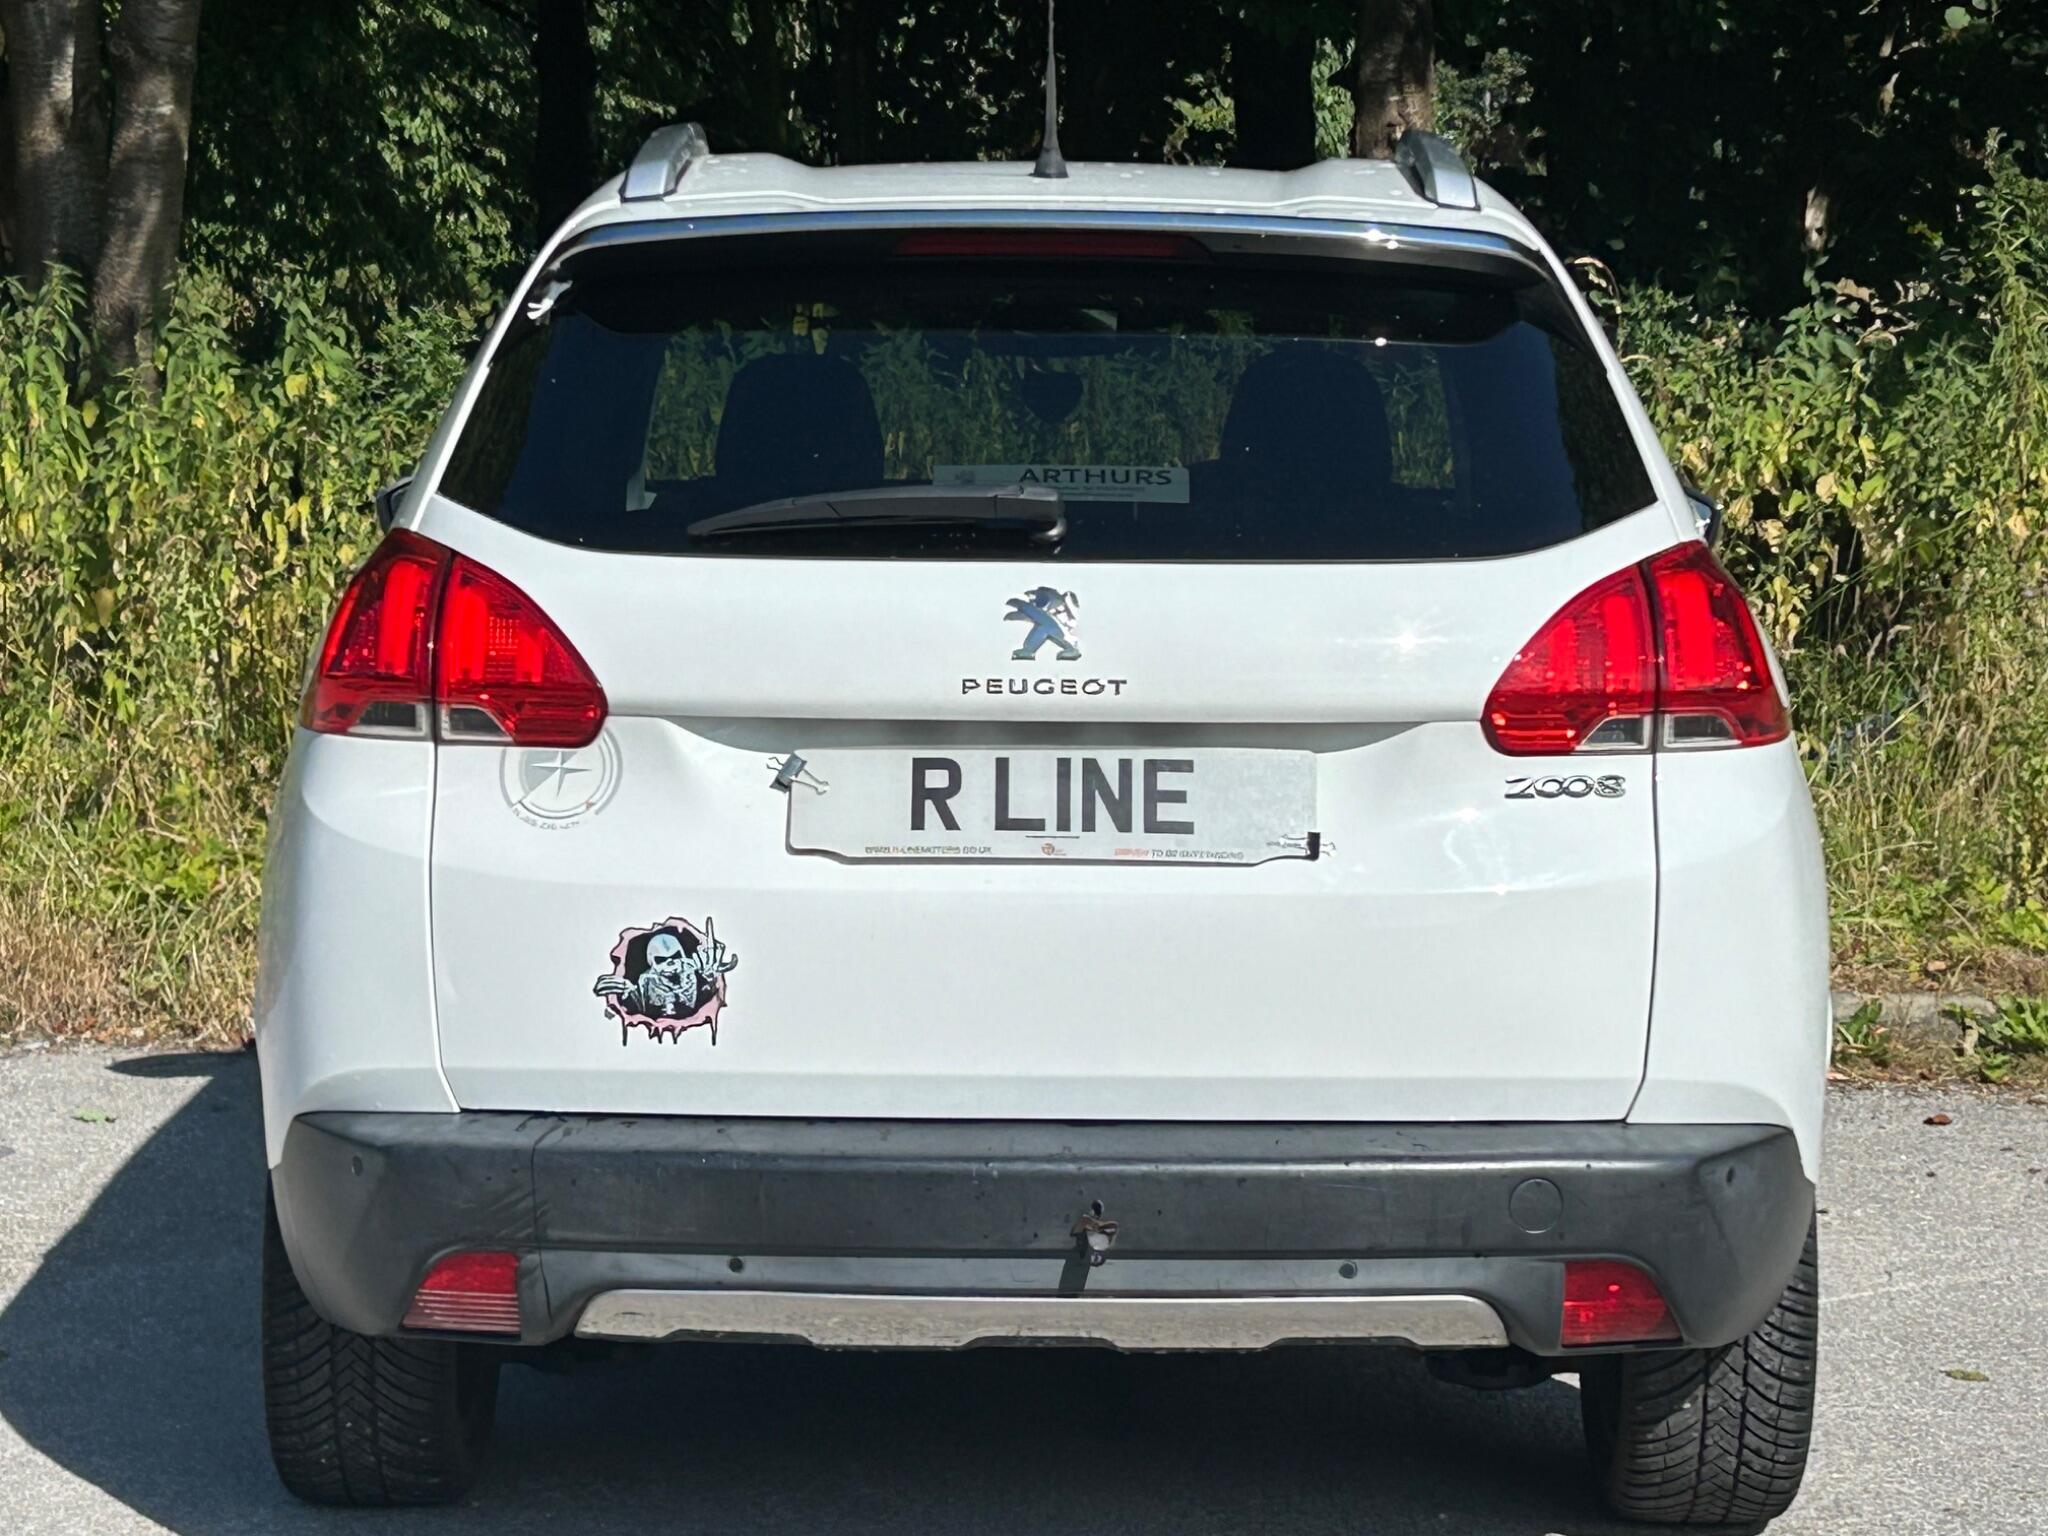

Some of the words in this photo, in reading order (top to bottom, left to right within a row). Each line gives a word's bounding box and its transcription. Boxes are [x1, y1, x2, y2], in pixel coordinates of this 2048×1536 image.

[1019, 468, 1172, 485] ARTHURS
[961, 678, 1127, 695] PEUGEOT
[911, 757, 962, 831] R
[994, 757, 1194, 834] LINE
[1504, 774, 1626, 799] 2008
